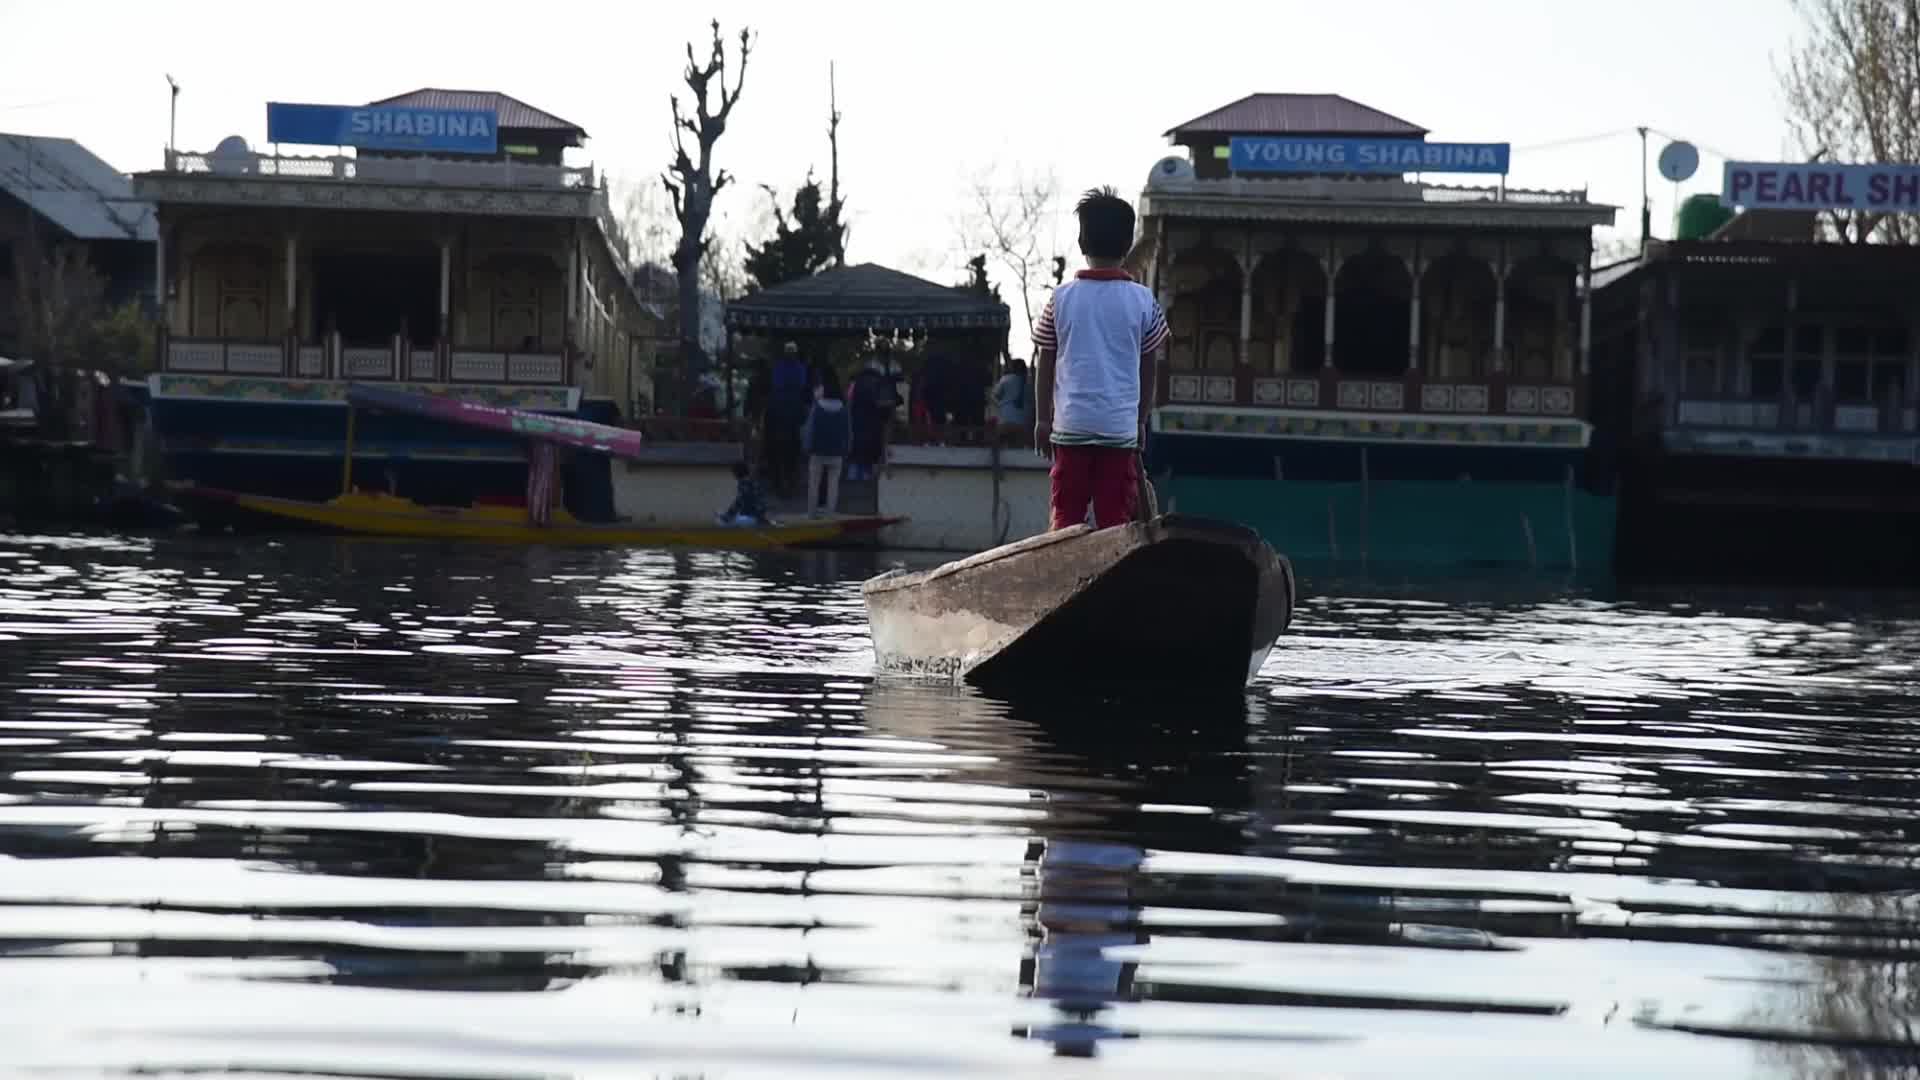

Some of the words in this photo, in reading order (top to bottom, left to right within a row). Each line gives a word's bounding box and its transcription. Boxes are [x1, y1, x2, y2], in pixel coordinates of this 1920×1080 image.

[351, 111, 490, 137] SHABINA
[1243, 142, 1345, 162] YOUNG
[1358, 144, 1497, 167] SHABINA
[1731, 170, 1854, 205] PEARL
